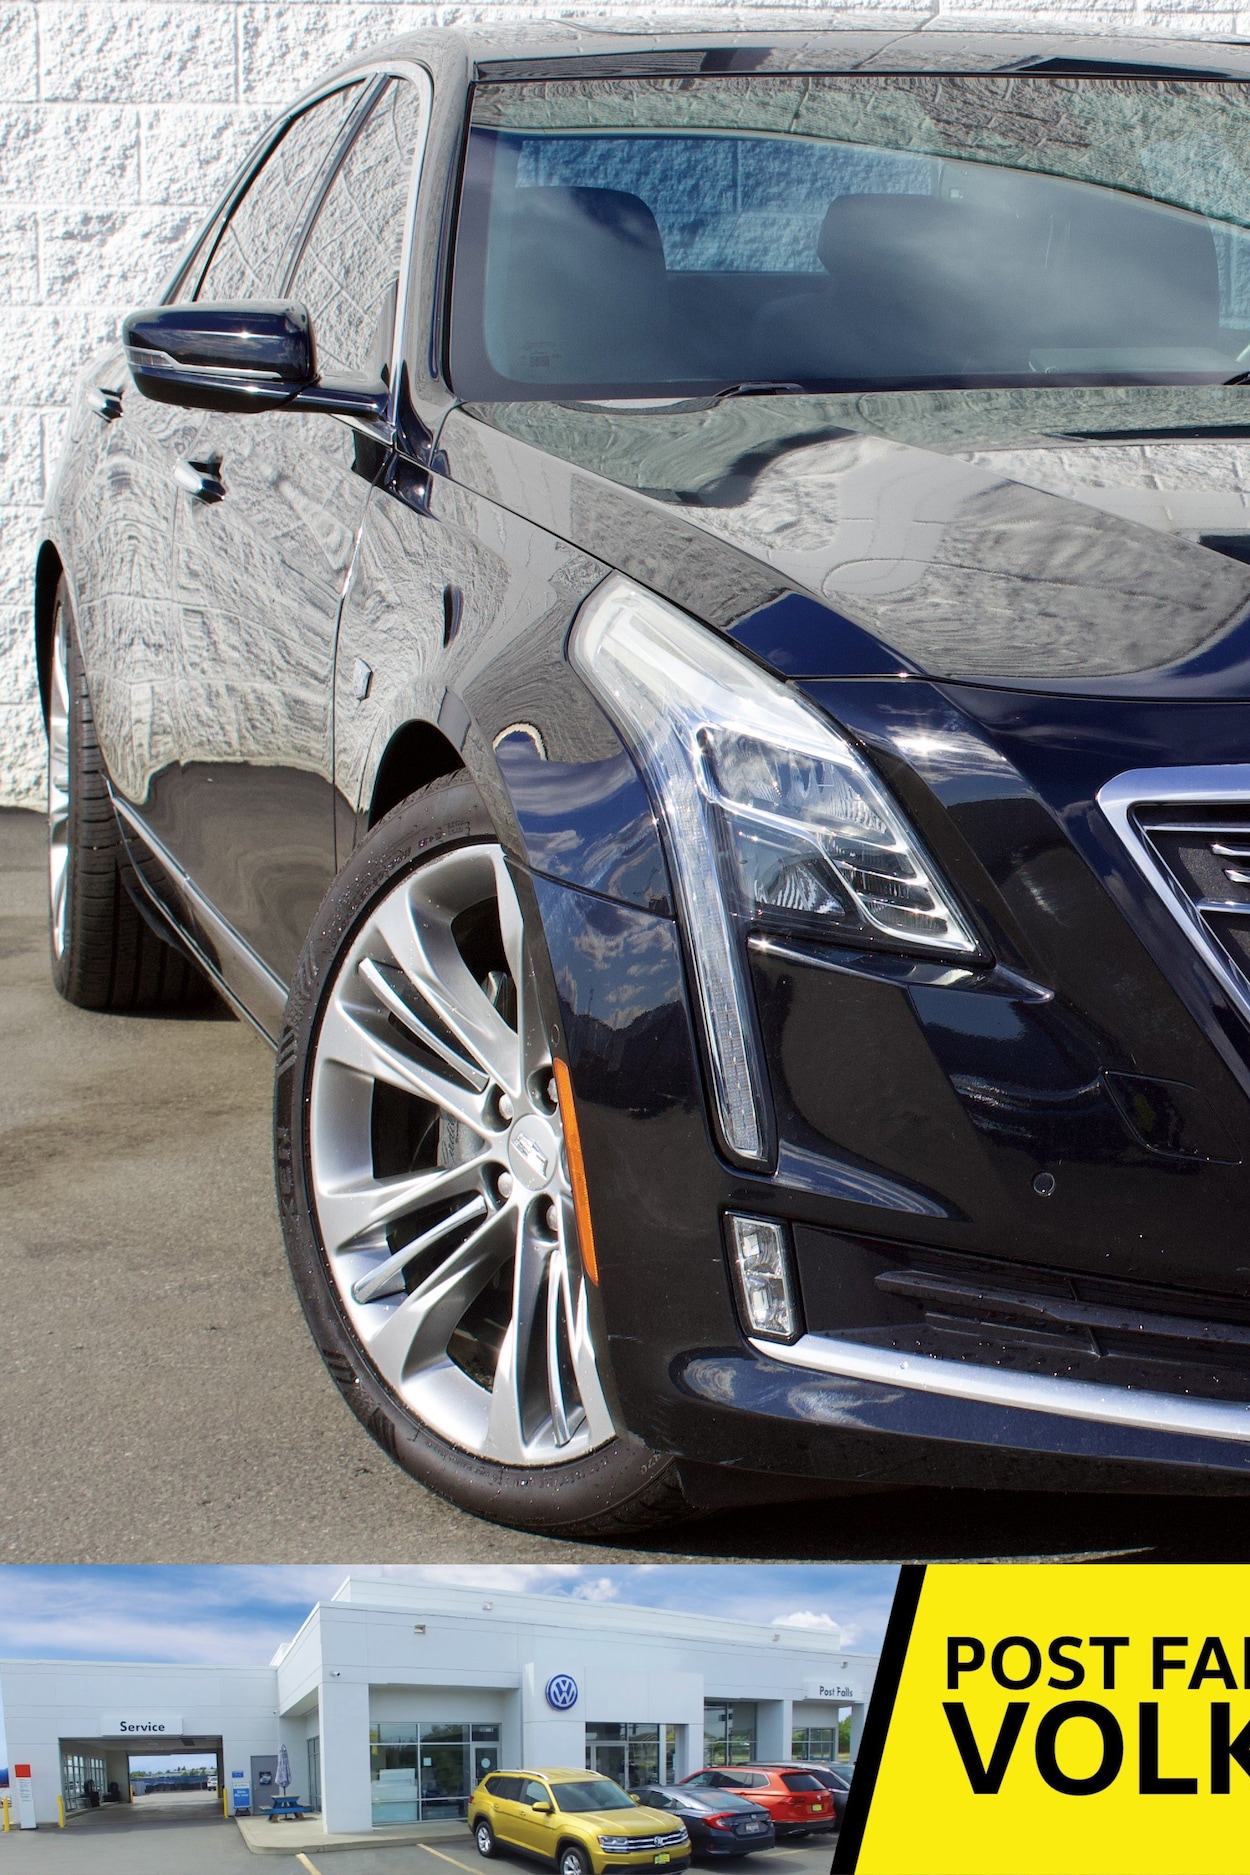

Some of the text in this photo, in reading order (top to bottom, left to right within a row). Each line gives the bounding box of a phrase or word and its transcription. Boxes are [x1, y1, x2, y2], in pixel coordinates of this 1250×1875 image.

[819, 1685, 853, 1697] Post Falls
[119, 1720, 165, 1732] Service
